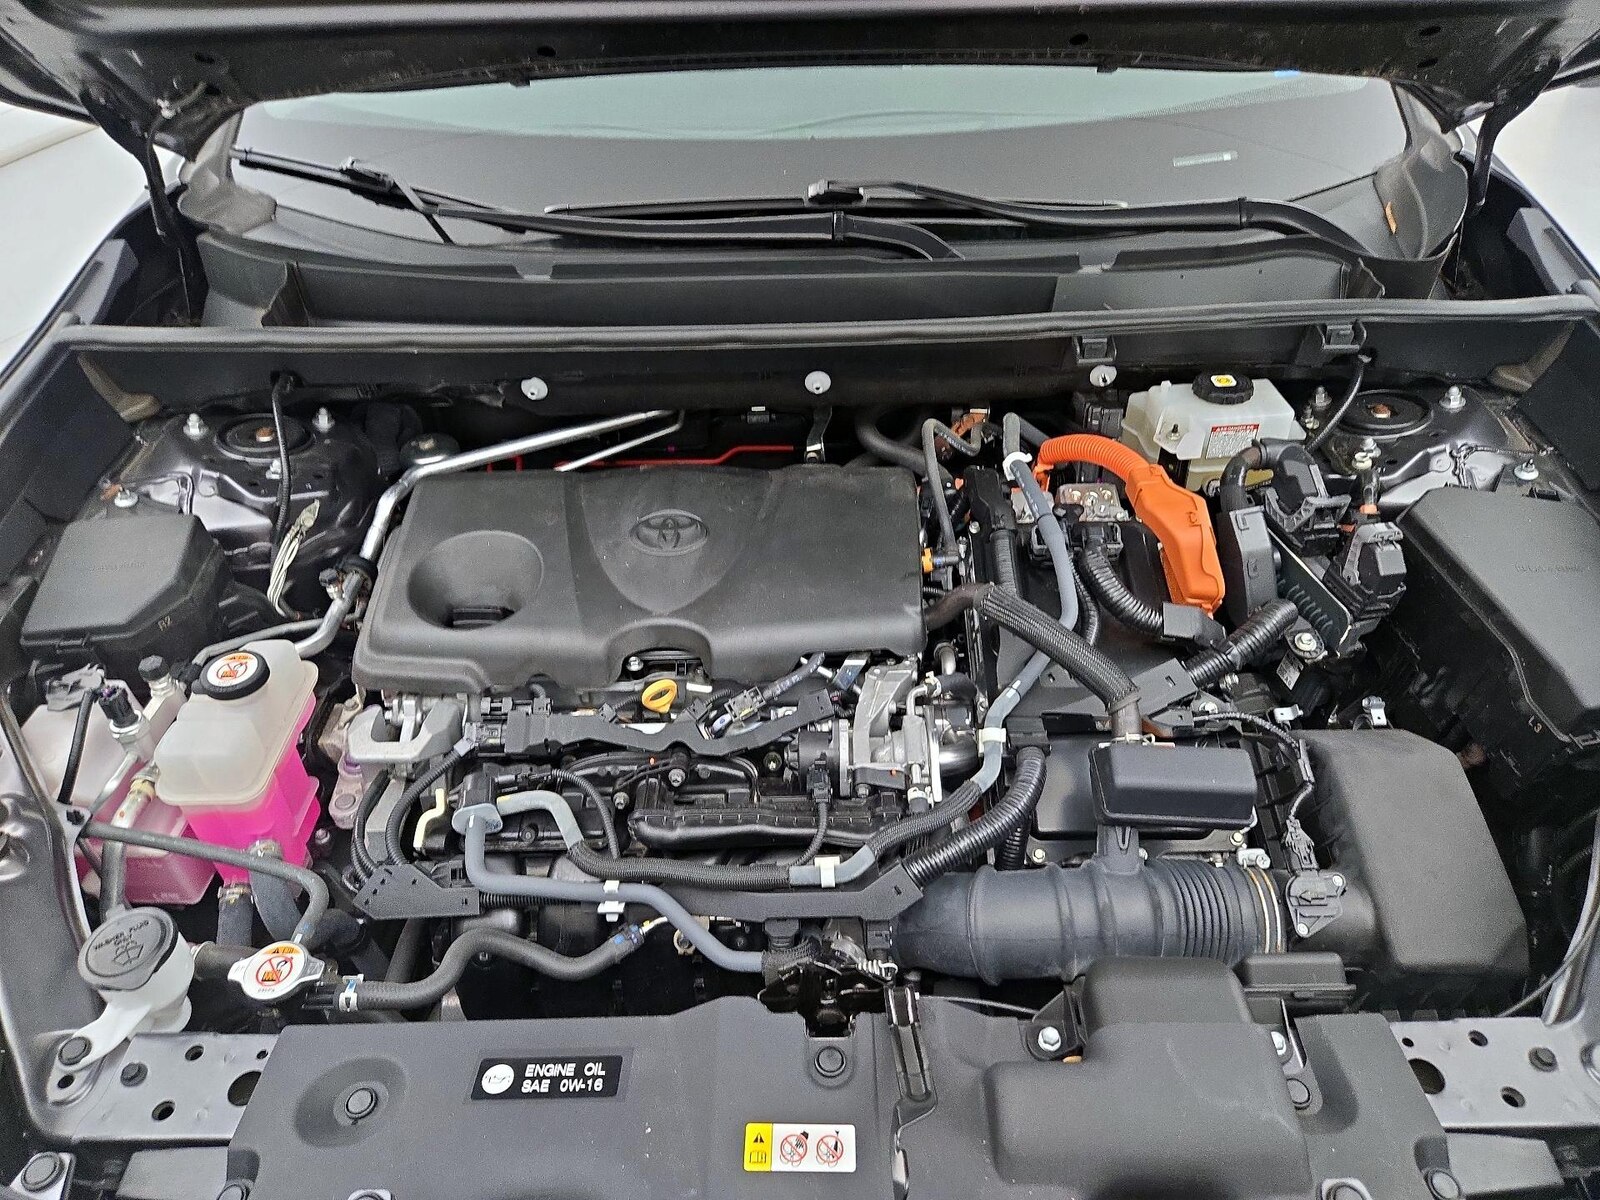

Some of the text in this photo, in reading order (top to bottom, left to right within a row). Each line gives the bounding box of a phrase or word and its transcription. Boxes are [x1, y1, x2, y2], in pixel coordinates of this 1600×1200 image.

[525, 1062, 606, 1077] ENGINE OIL
[521, 1078, 604, 1093] SAE 0W-16
